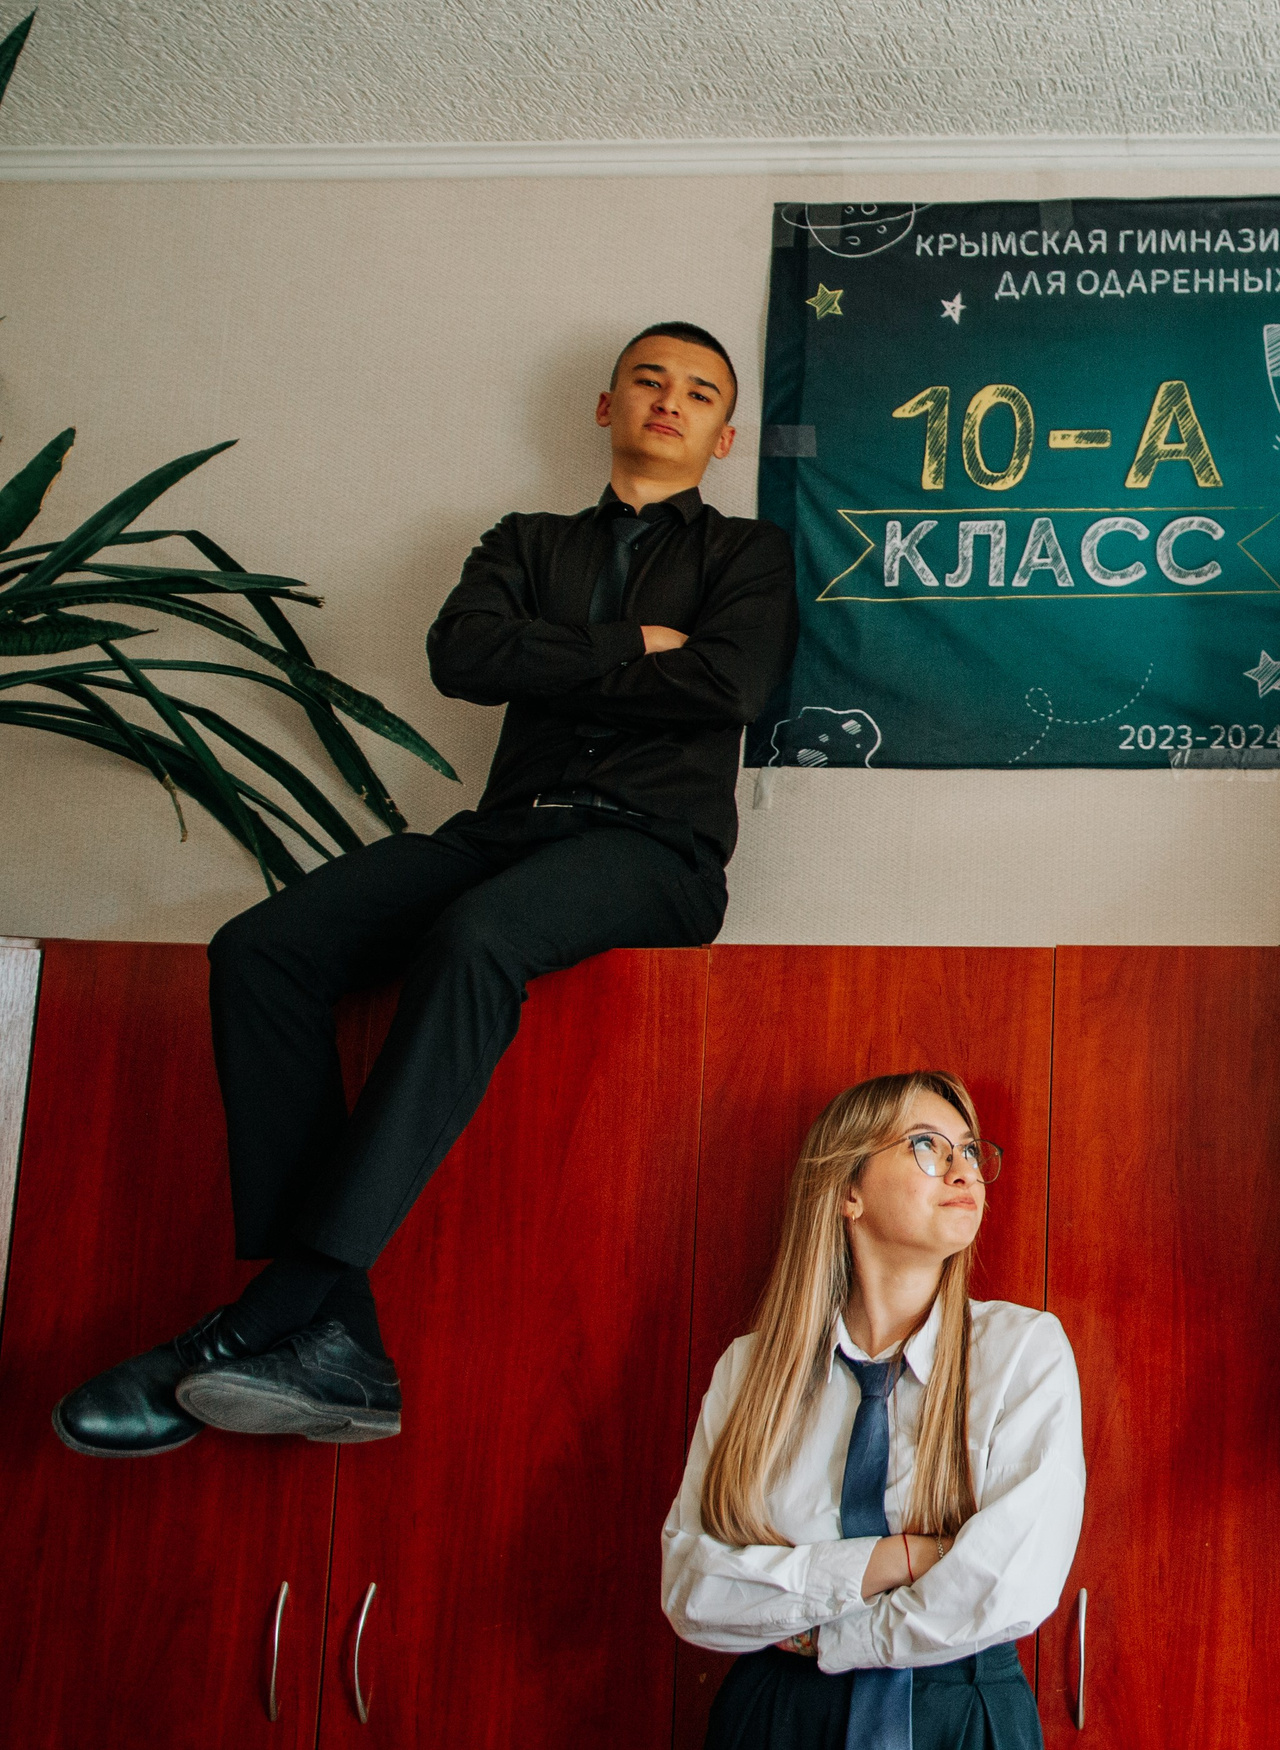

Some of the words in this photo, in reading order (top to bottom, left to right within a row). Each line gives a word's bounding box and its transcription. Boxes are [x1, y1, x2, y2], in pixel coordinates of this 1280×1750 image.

[915, 229, 1107, 257] КРЫМСКАЯ
[994, 269, 1066, 300] ДЛЯ
[891, 380, 1224, 491] 10-А
[883, 516, 1226, 588] КЛАСС
